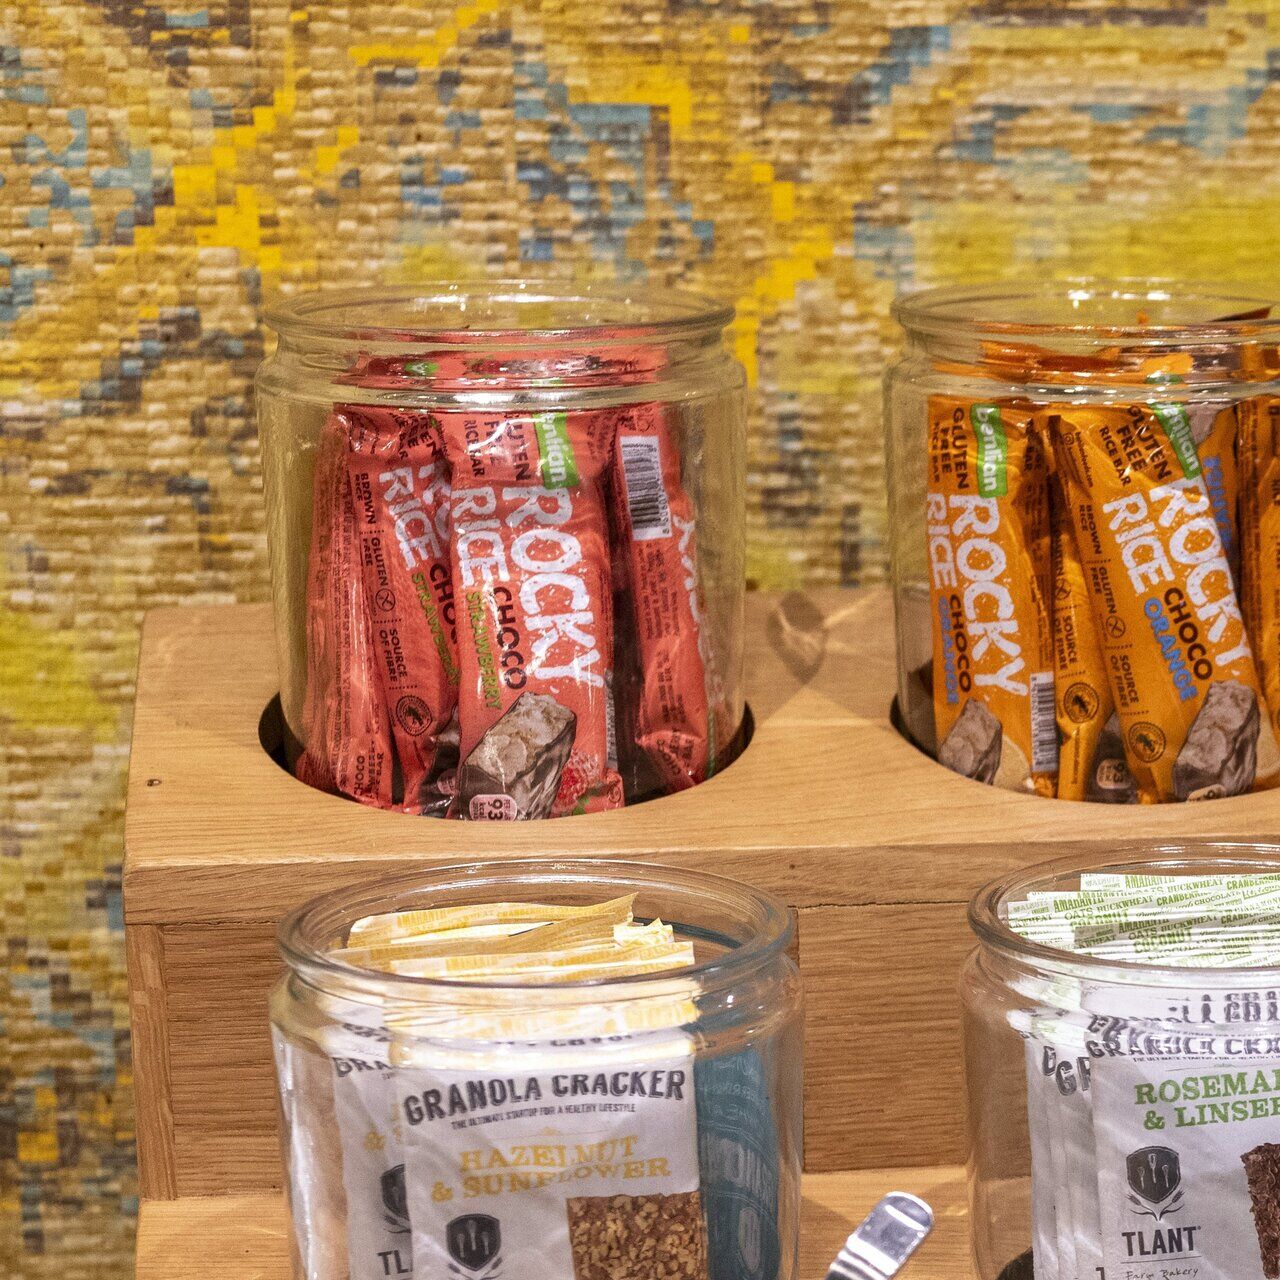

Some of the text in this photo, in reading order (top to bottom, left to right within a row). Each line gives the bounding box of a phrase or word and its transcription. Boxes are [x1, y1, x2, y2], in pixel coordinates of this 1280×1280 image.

[952, 407, 970, 489] GLUTEN
[976, 407, 1003, 491] benlian
[1099, 425, 1118, 459] RICE
[1115, 425, 1148, 472] FREE
[1127, 405, 1172, 481] GLUTEN
[361, 473, 376, 525] BROWN
[379, 467, 443, 570] RICE
[1078, 505, 1088, 531] RICE
[451, 486, 511, 588] RICE
[927, 493, 957, 590] RICE
[1086, 505, 1102, 555] BROWN
[1102, 493, 1176, 594] RICE
[371, 537, 388, 586] GLUTEN
[502, 485, 604, 688] ROCKY
[1090, 567, 1102, 595] FREE
[1149, 473, 1253, 667] ROCKY
[948, 495, 1029, 696] ROCKY
[1100, 567, 1118, 614] GLUTEN
[380, 629, 398, 682] OF FIBRE
[389, 628, 407, 678] SOURCE
[466, 591, 502, 710] STRAWBERRY
[493, 586, 527, 689] CHOCO
[950, 594, 972, 693] CHOCO
[1062, 615, 1078, 664] SOURCE
[1143, 597, 1198, 702] ORANGE
[1164, 587, 1213, 681] CHOCO
[1110, 655, 1129, 708] OF FIBRE
[1119, 654, 1139, 704] SOURCE
[1053, 897, 1105, 913] AMARANTH
[1064, 907, 1094, 921] OATS
[1096, 895, 1155, 913] BUCKWHEAT
[1128, 928, 1157, 940] OATS
[403, 1069, 686, 1126] GRANOLA CRACKER
[539, 1106, 555, 1116] FOR
[1143, 1110, 1166, 1130] &
[460, 1136, 639, 1172] HAZELNUT
[431, 1157, 672, 1203] & SUNFLOWER
[1121, 1226, 1198, 1257] TLANT
[1125, 1267, 1200, 1280] Farm Bakery
